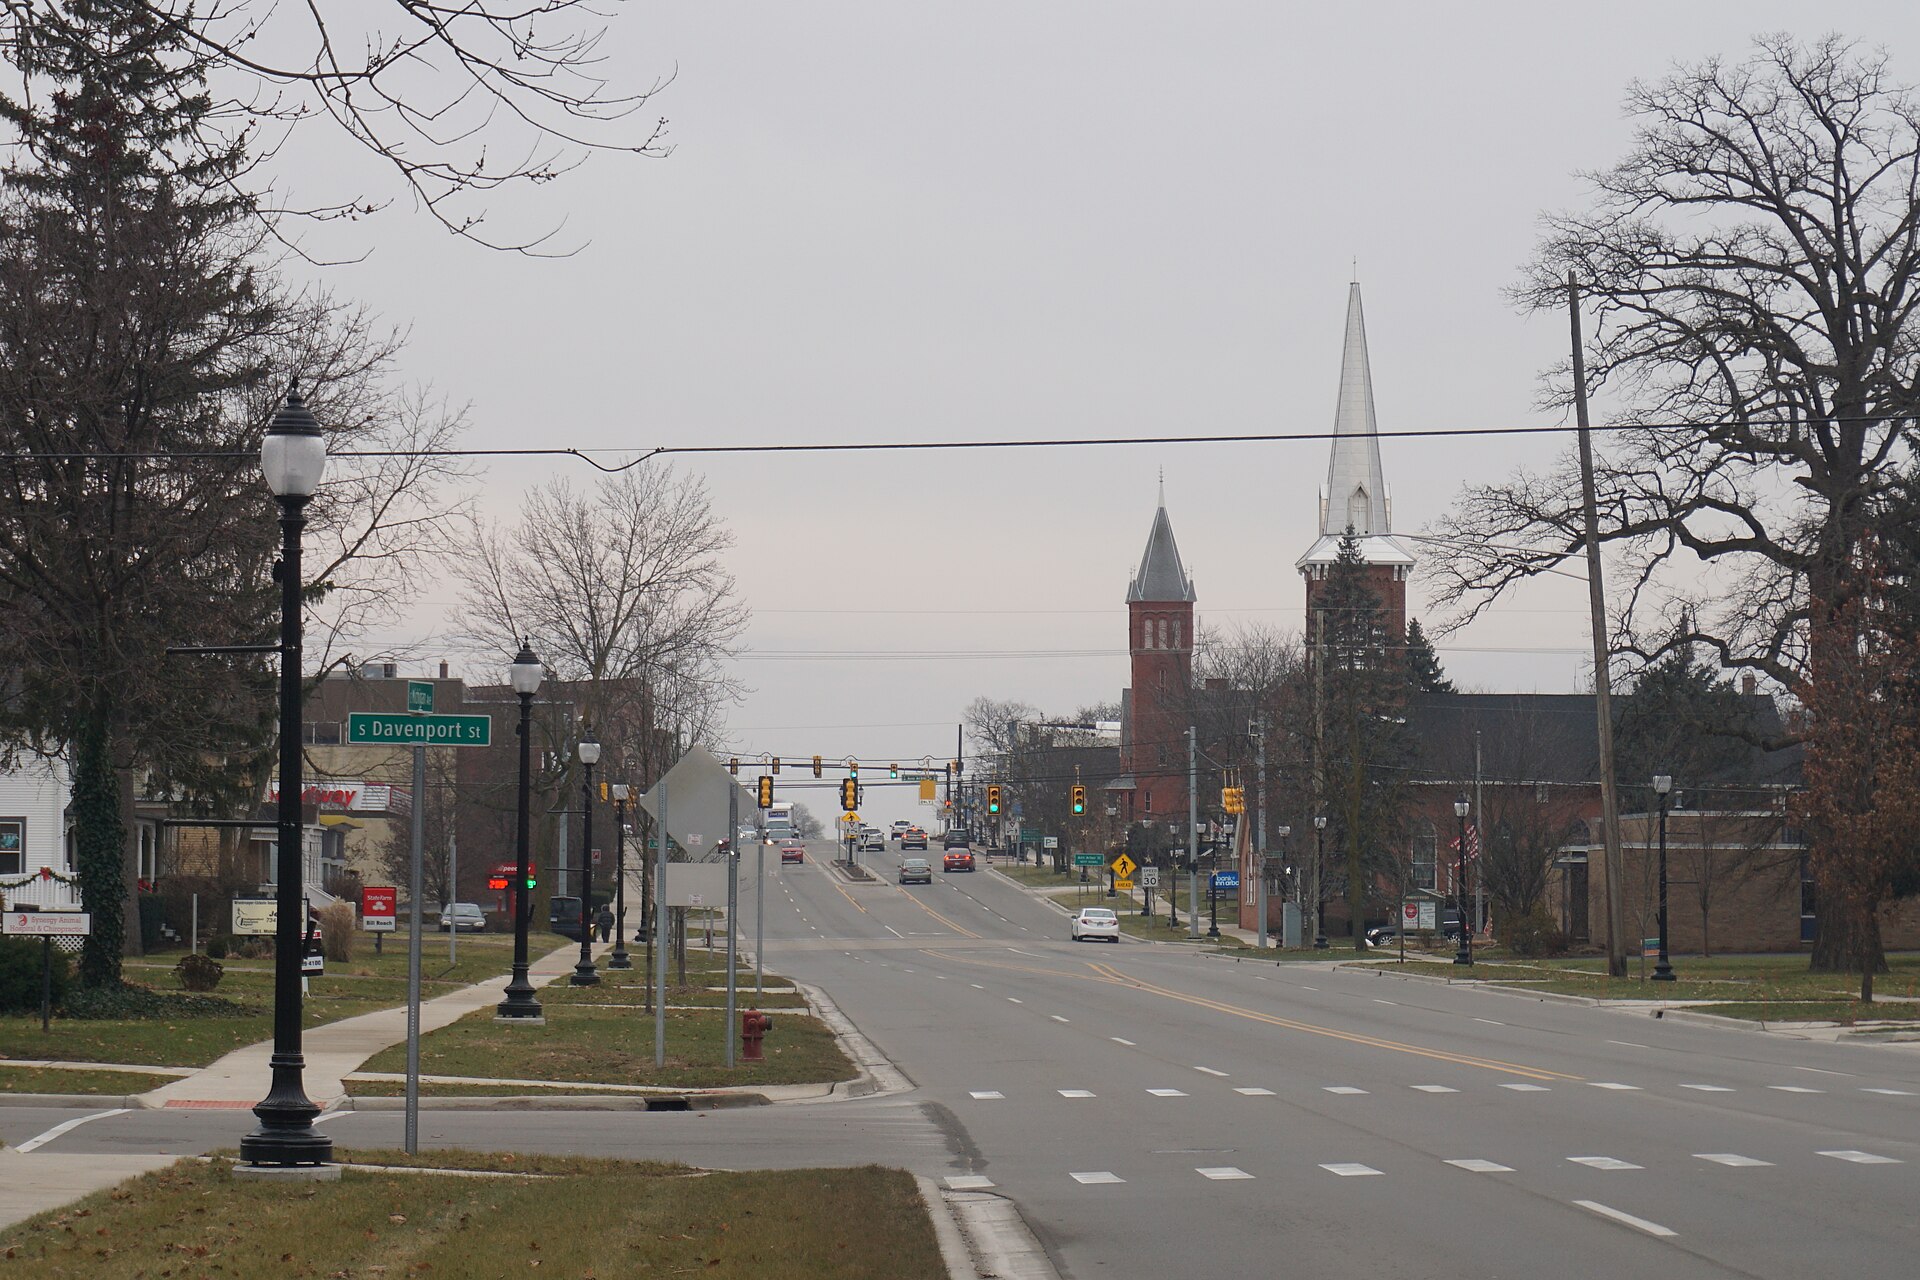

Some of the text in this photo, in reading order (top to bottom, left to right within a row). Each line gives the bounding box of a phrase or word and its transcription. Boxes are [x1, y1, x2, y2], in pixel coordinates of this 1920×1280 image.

[372, 720, 462, 741] Davenport
[468, 726, 480, 739] St
[31, 916, 82, 925] Synergy Animal
[10, 925, 36, 933] Hospital
[43, 925, 83, 934] Chiropractic
